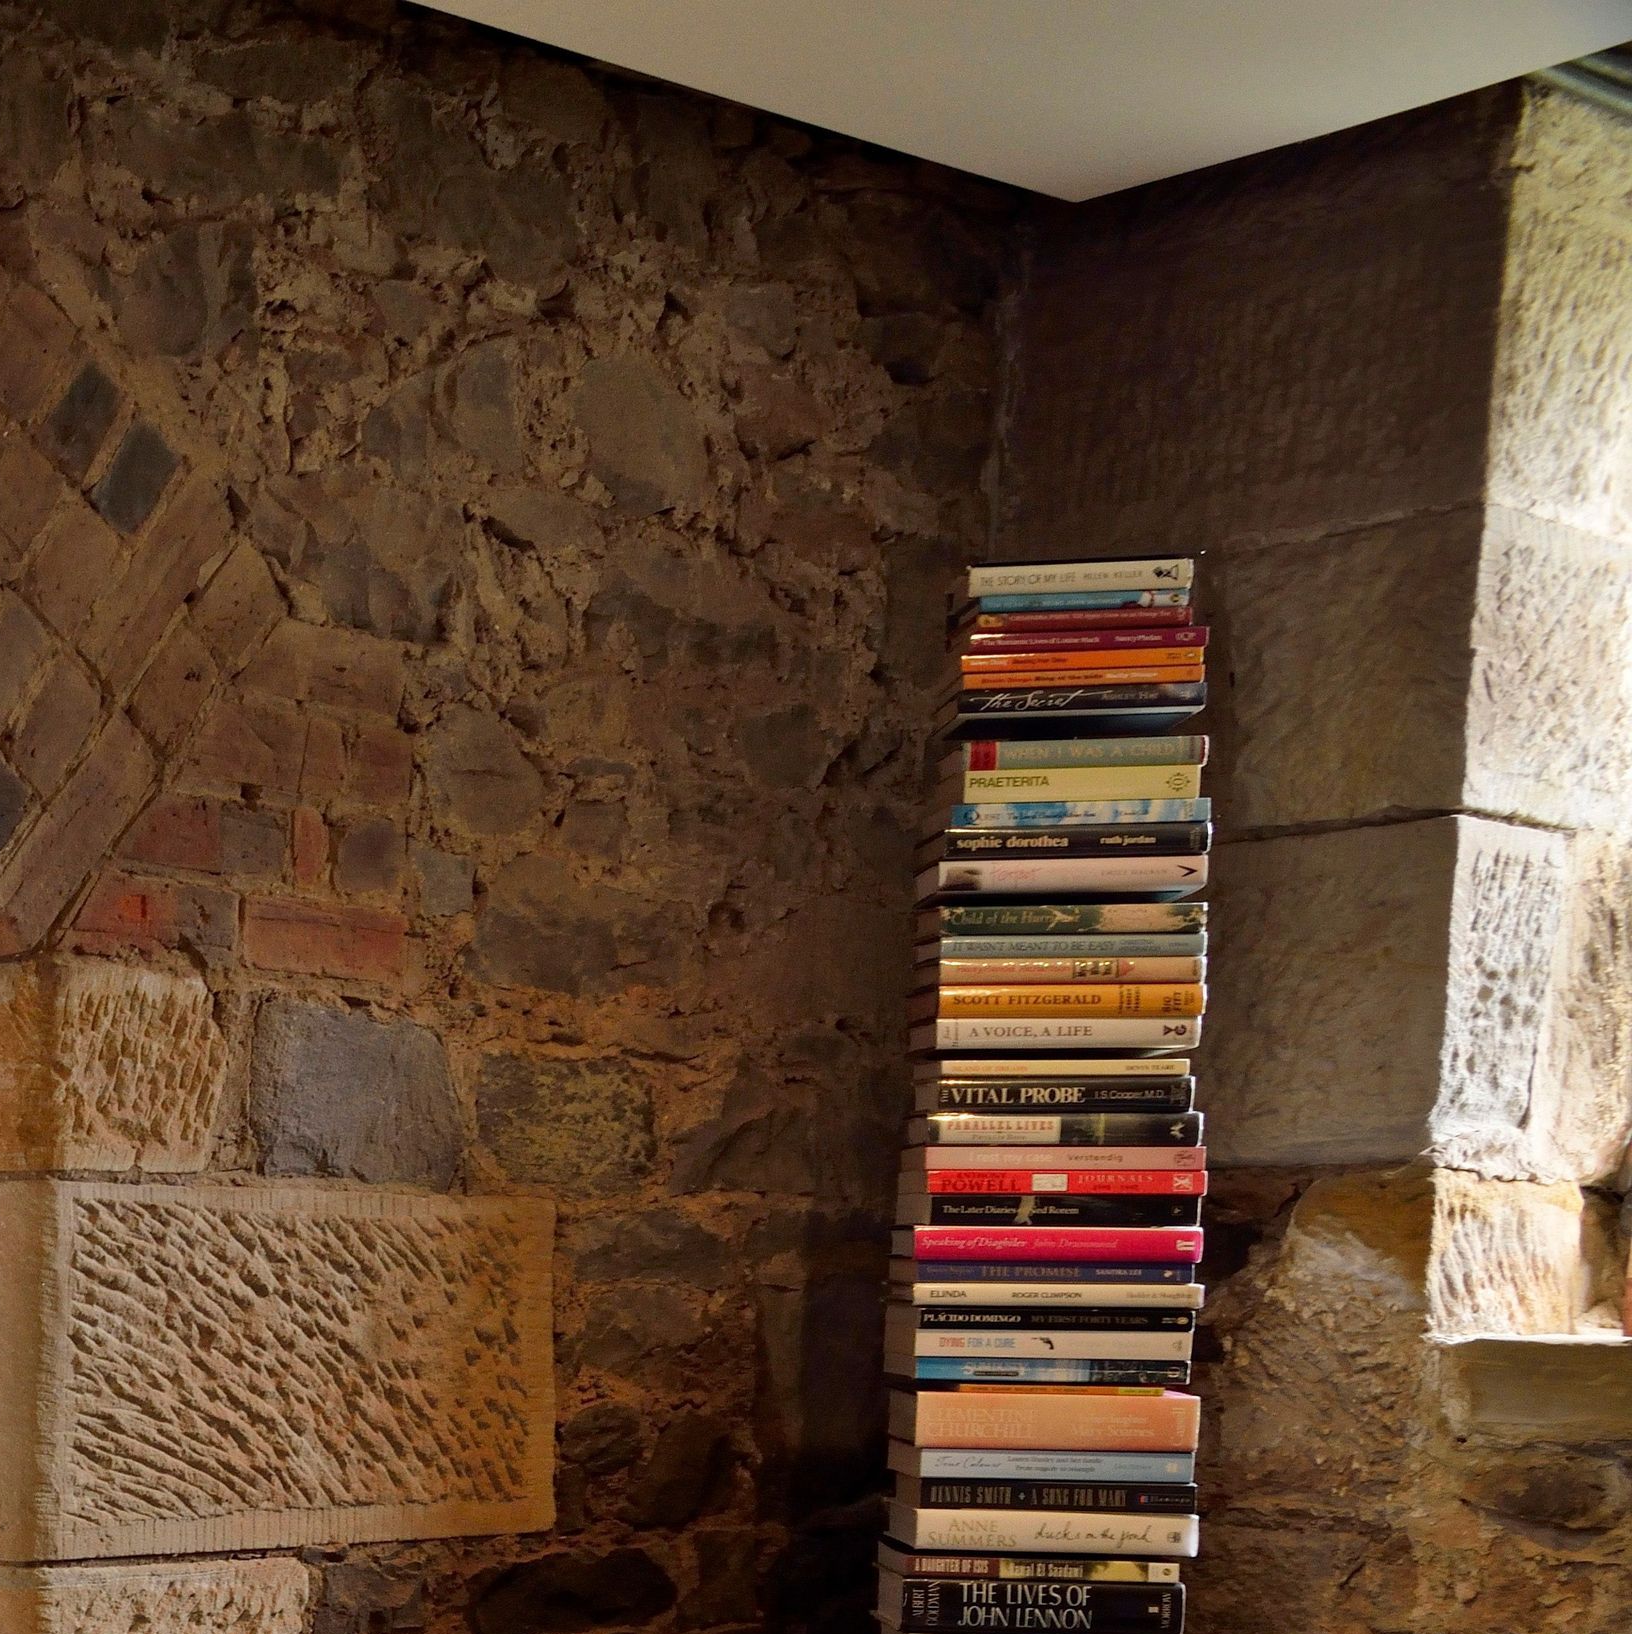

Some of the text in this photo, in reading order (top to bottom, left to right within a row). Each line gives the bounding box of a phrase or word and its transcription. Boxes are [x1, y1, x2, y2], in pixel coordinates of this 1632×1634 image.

[968, 776, 1050, 789] PRAETERITA
[956, 837, 1069, 851] sophie dorothea
[953, 995, 1101, 1005] SCOTT FITZGERALD
[951, 1087, 1086, 1103] VITAL PROBE
[941, 1180, 1021, 1191] POWELL
[928, 1534, 1016, 1547] SUMMERS
[959, 1583, 1092, 1606] THE LIVES OF
[958, 1606, 1092, 1629] JOHN LENNON
